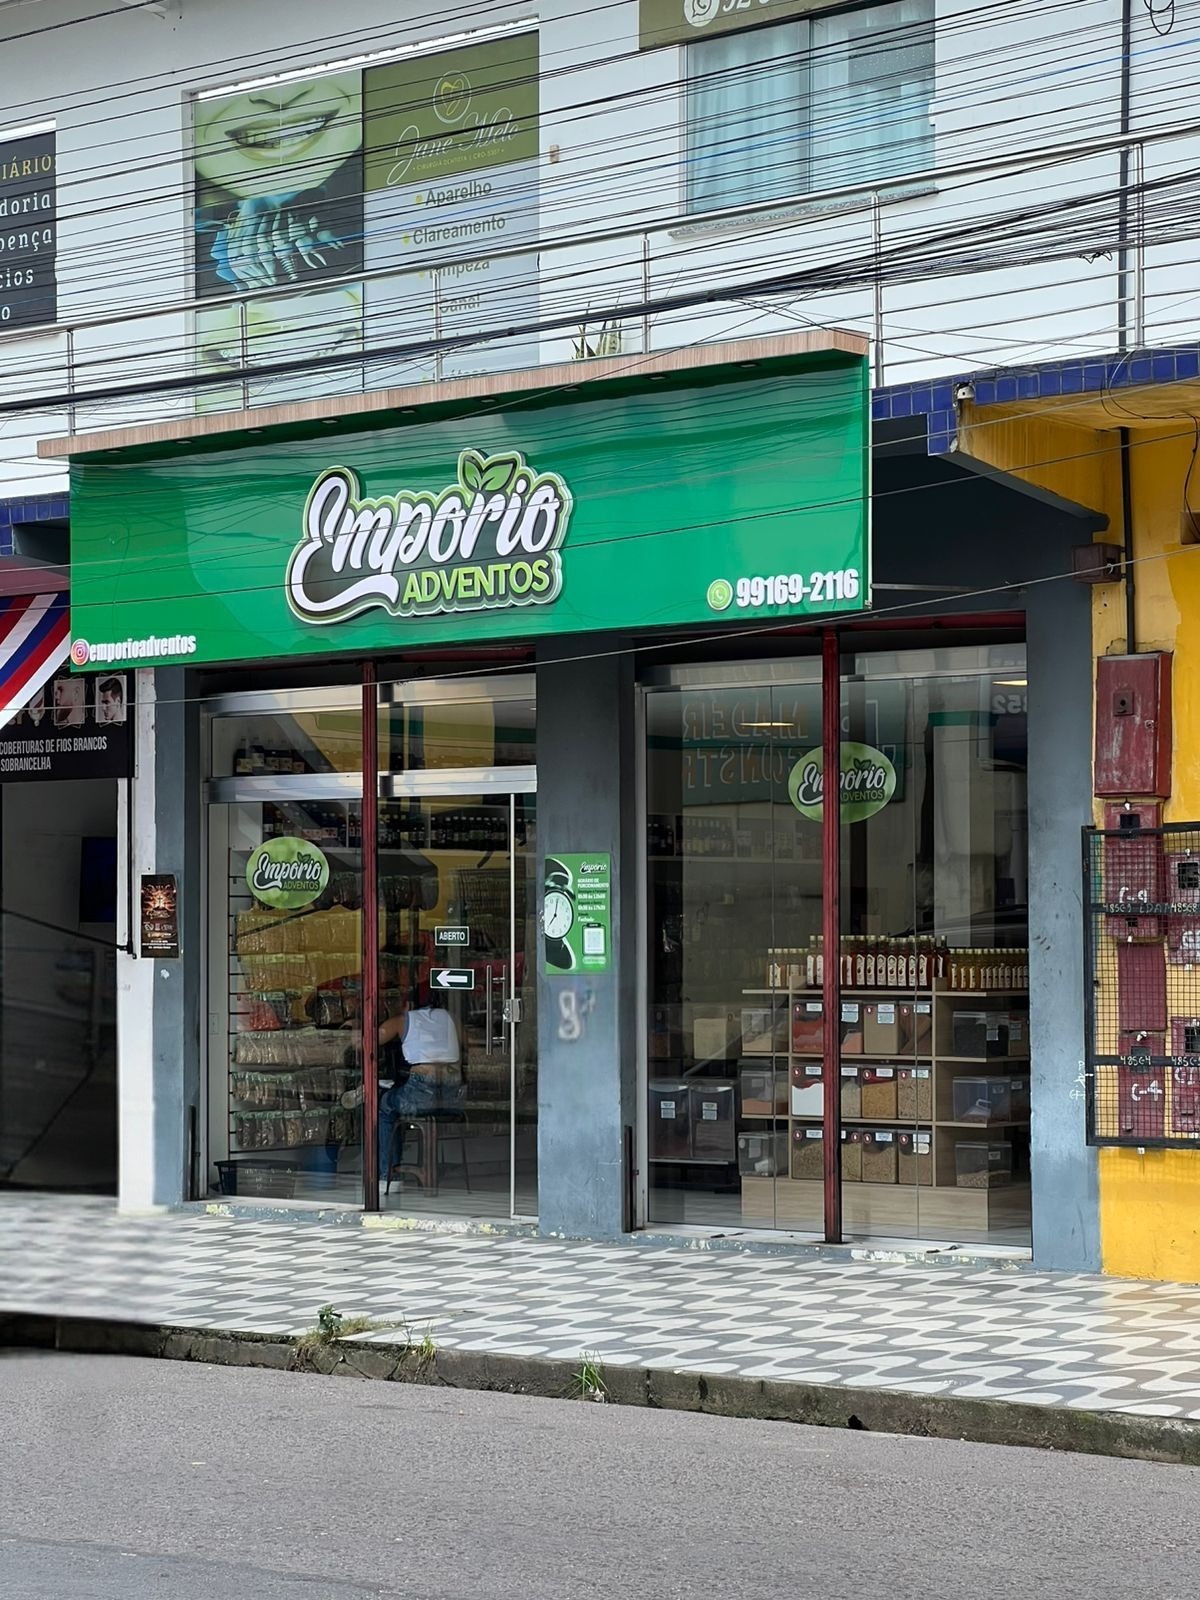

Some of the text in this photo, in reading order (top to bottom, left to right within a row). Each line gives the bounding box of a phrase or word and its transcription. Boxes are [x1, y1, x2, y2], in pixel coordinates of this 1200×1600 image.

[425, 181, 492, 207] Aparelho
[413, 216, 506, 245] Clareamento
[290, 476, 561, 612] Emporio
[402, 559, 550, 604] ADVENTOS
[736, 568, 859, 607] 99169-2116
[89, 634, 197, 663] emporioadventos
[0, 736, 107, 755] COBERTURAS DE FIOS BRANCOS
[0, 756, 52, 772] SOBRANCELHA
[840, 789, 884, 801] DVENTOS
[253, 853, 322, 889] Emporio
[283, 881, 319, 890] ADVENTOS
[439, 931, 466, 941] ABERTO
